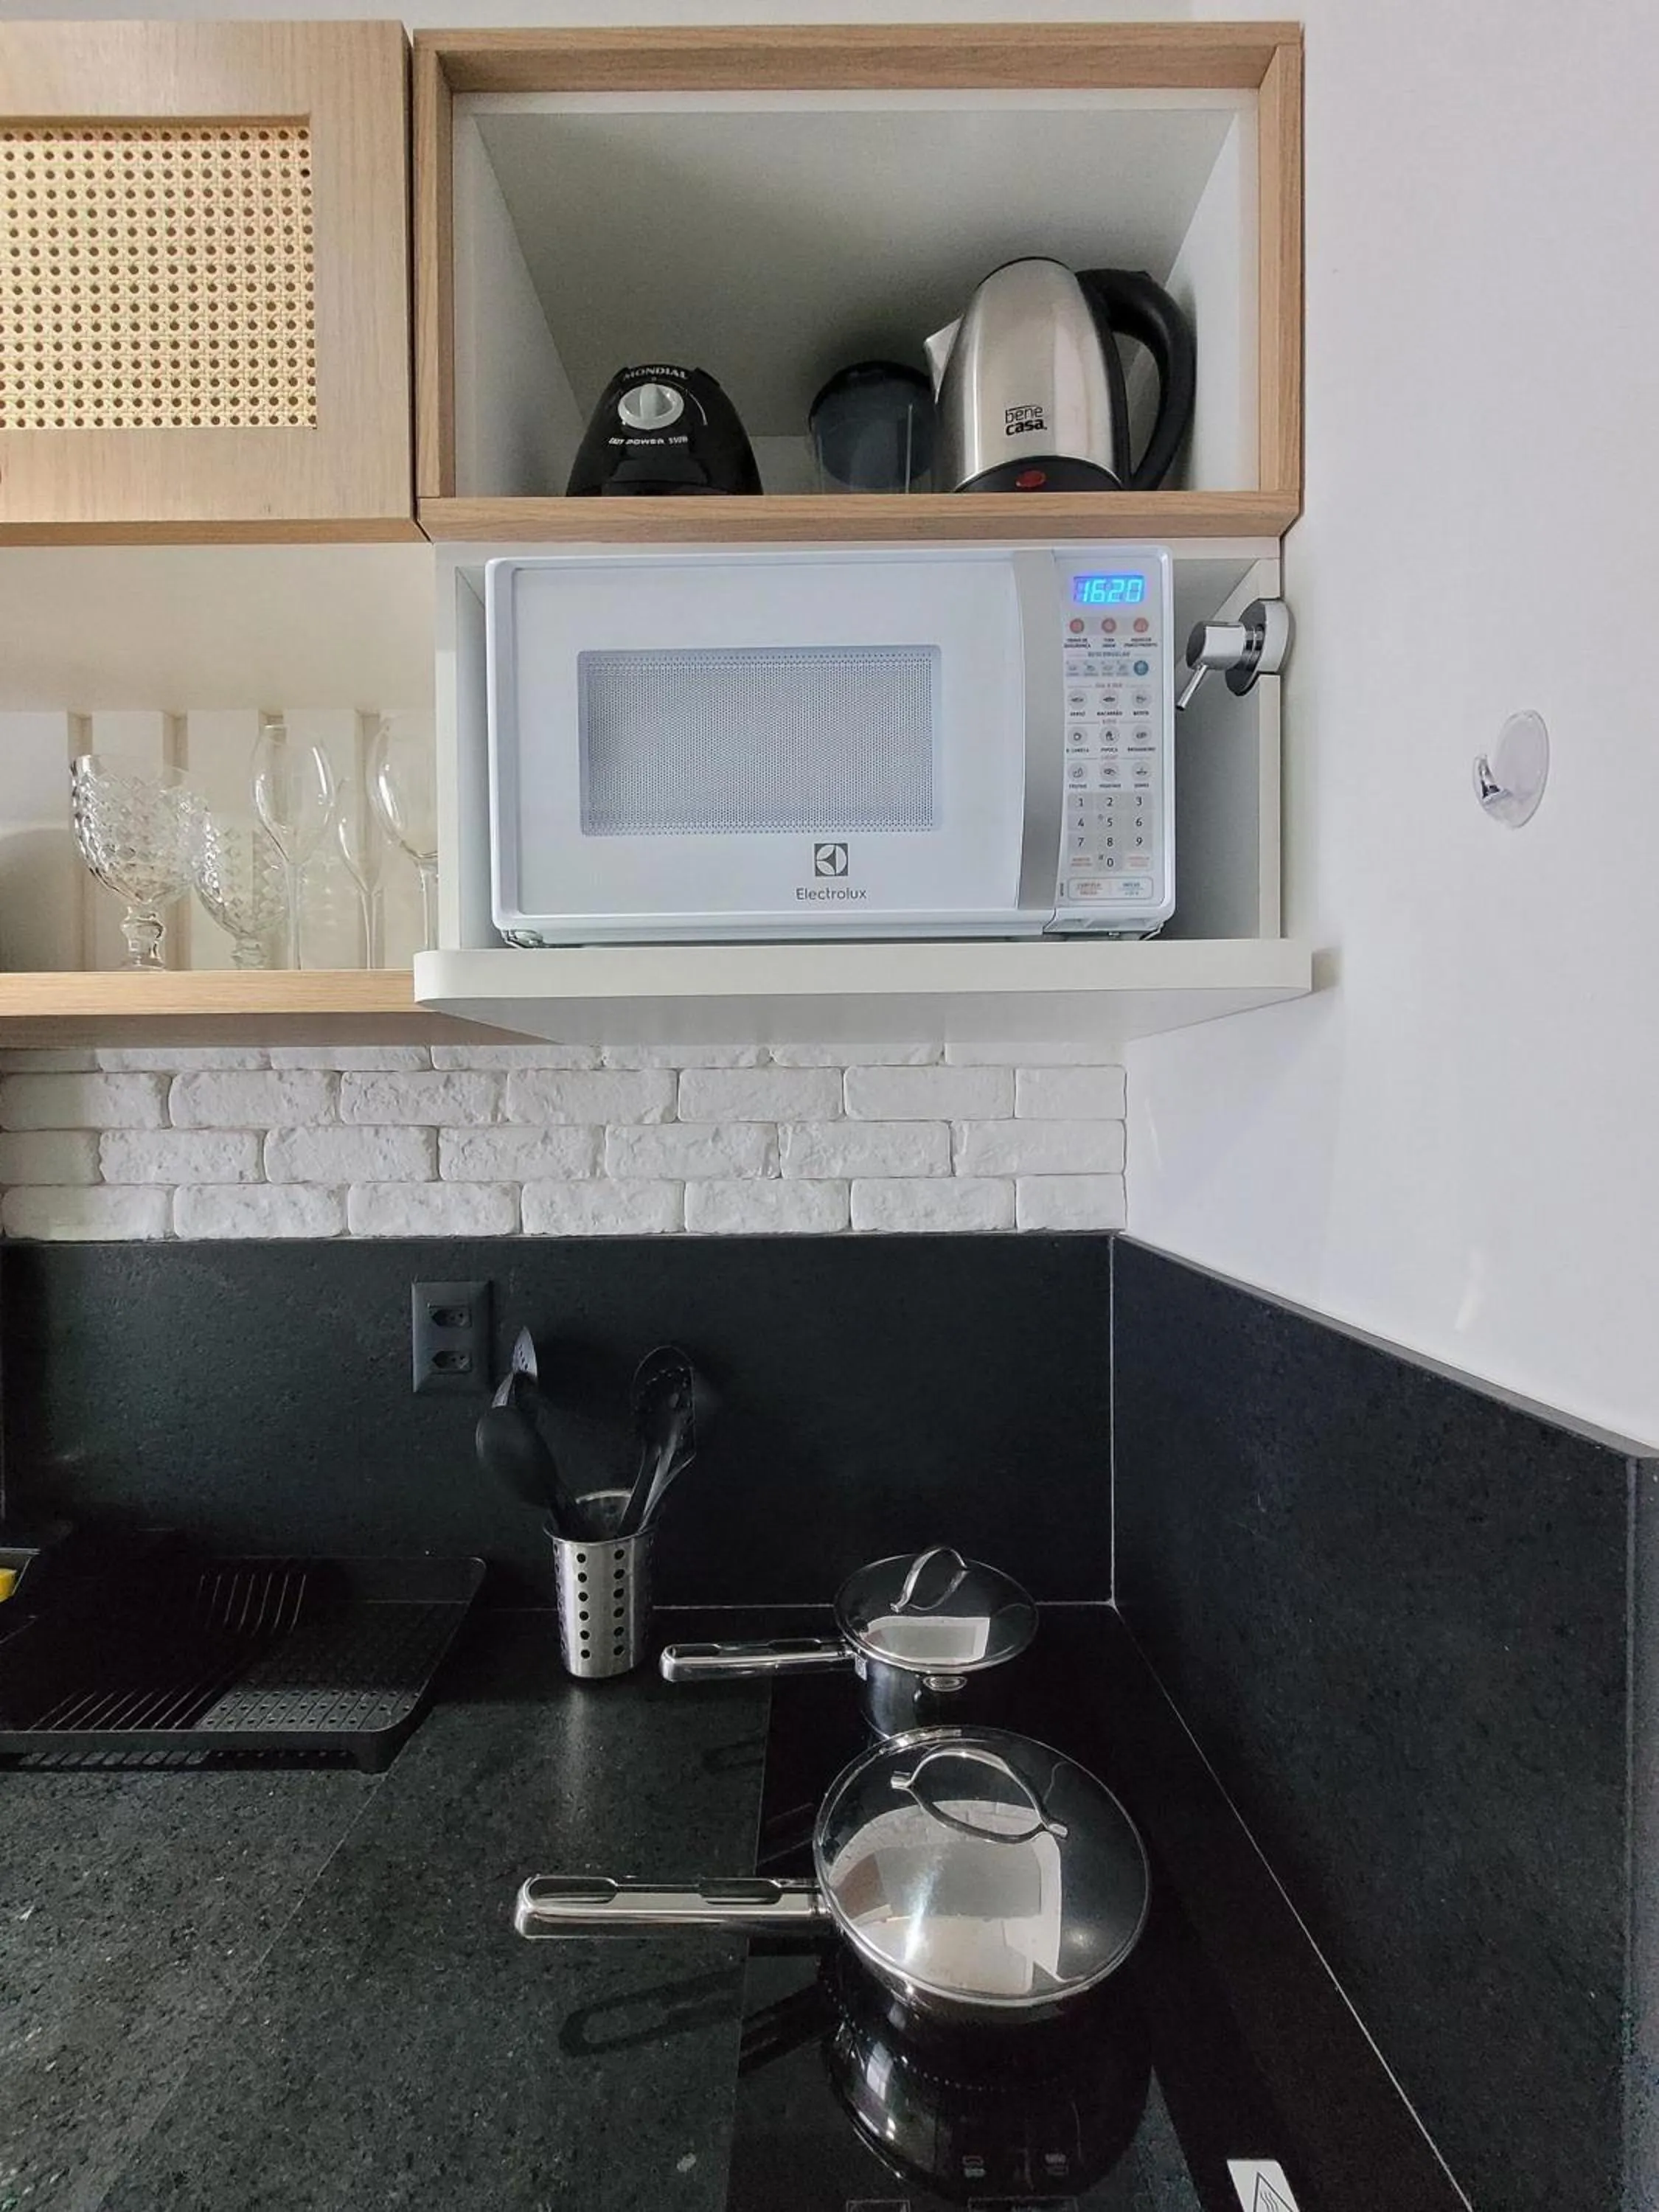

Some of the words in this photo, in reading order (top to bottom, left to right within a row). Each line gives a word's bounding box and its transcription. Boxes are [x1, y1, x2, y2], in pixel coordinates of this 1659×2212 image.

[623, 366, 689, 381] MONDIAL
[1005, 405, 1043, 424] bene
[625, 437, 665, 445] POWER
[1078, 797, 1084, 807] 1
[1107, 797, 1113, 807] 2
[1136, 797, 1143, 807] 3
[1077, 818, 1085, 827] 4
[1107, 818, 1113, 827] 5
[1135, 817, 1143, 827] 6
[1077, 838, 1085, 847] 7
[1107, 838, 1113, 847] 8
[1136, 837, 1143, 846] 9
[1107, 858, 1114, 867] 0
[796, 886, 868, 900] Electrolux
